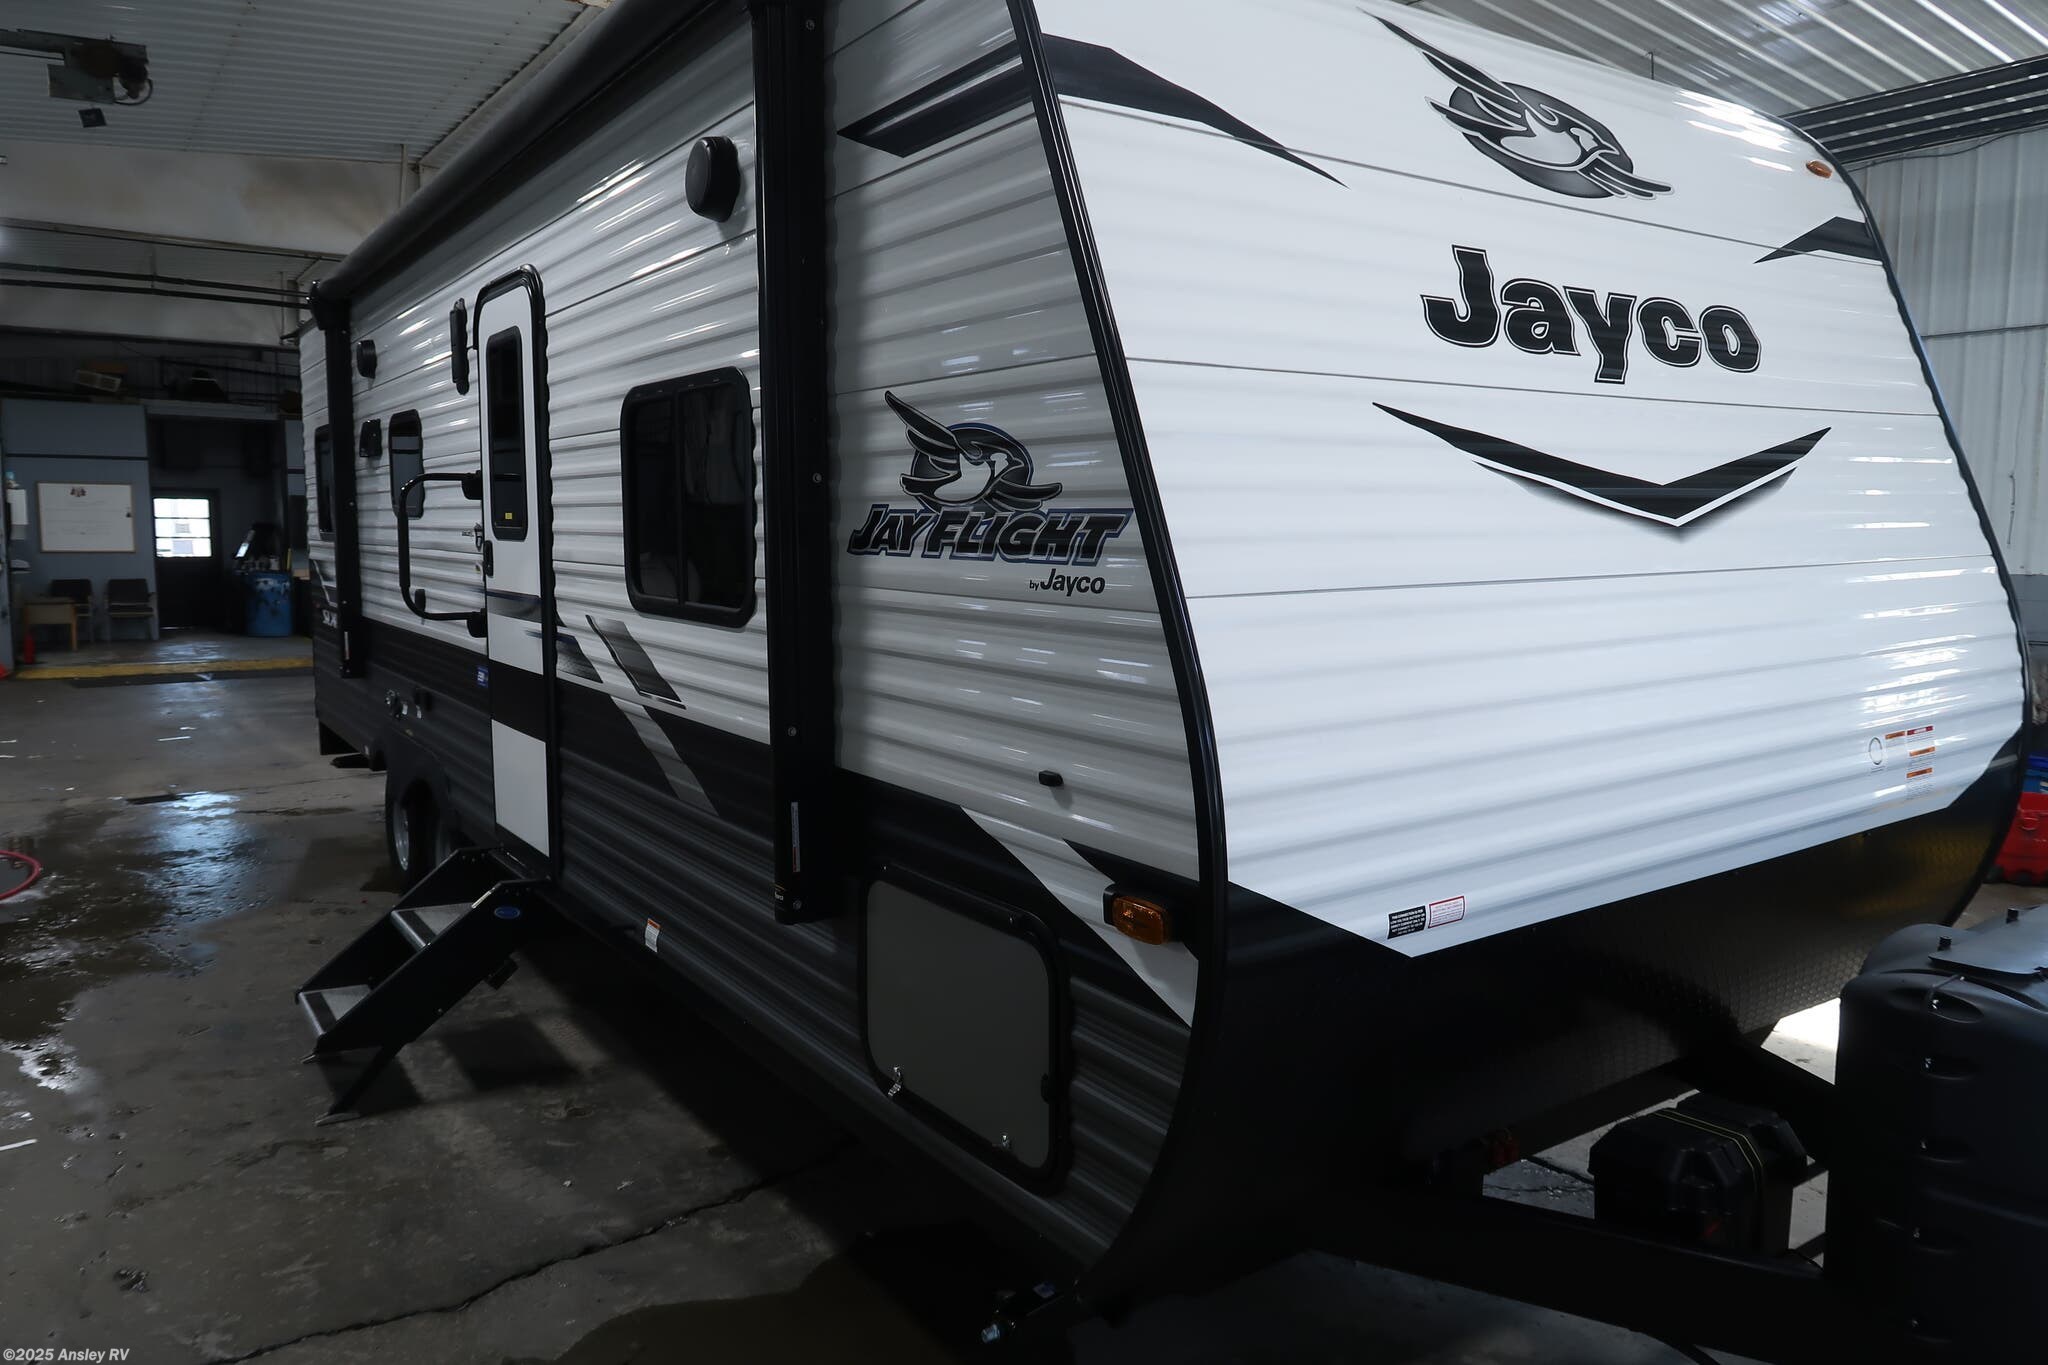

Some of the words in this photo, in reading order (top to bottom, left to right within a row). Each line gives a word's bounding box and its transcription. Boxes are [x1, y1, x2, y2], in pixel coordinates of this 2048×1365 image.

[1420, 244, 1762, 384] Jayco
[848, 504, 938, 557] JAY
[922, 508, 1135, 566] FLIGHT
[1029, 580, 1039, 591] by
[1040, 569, 1106, 596] Jayco
